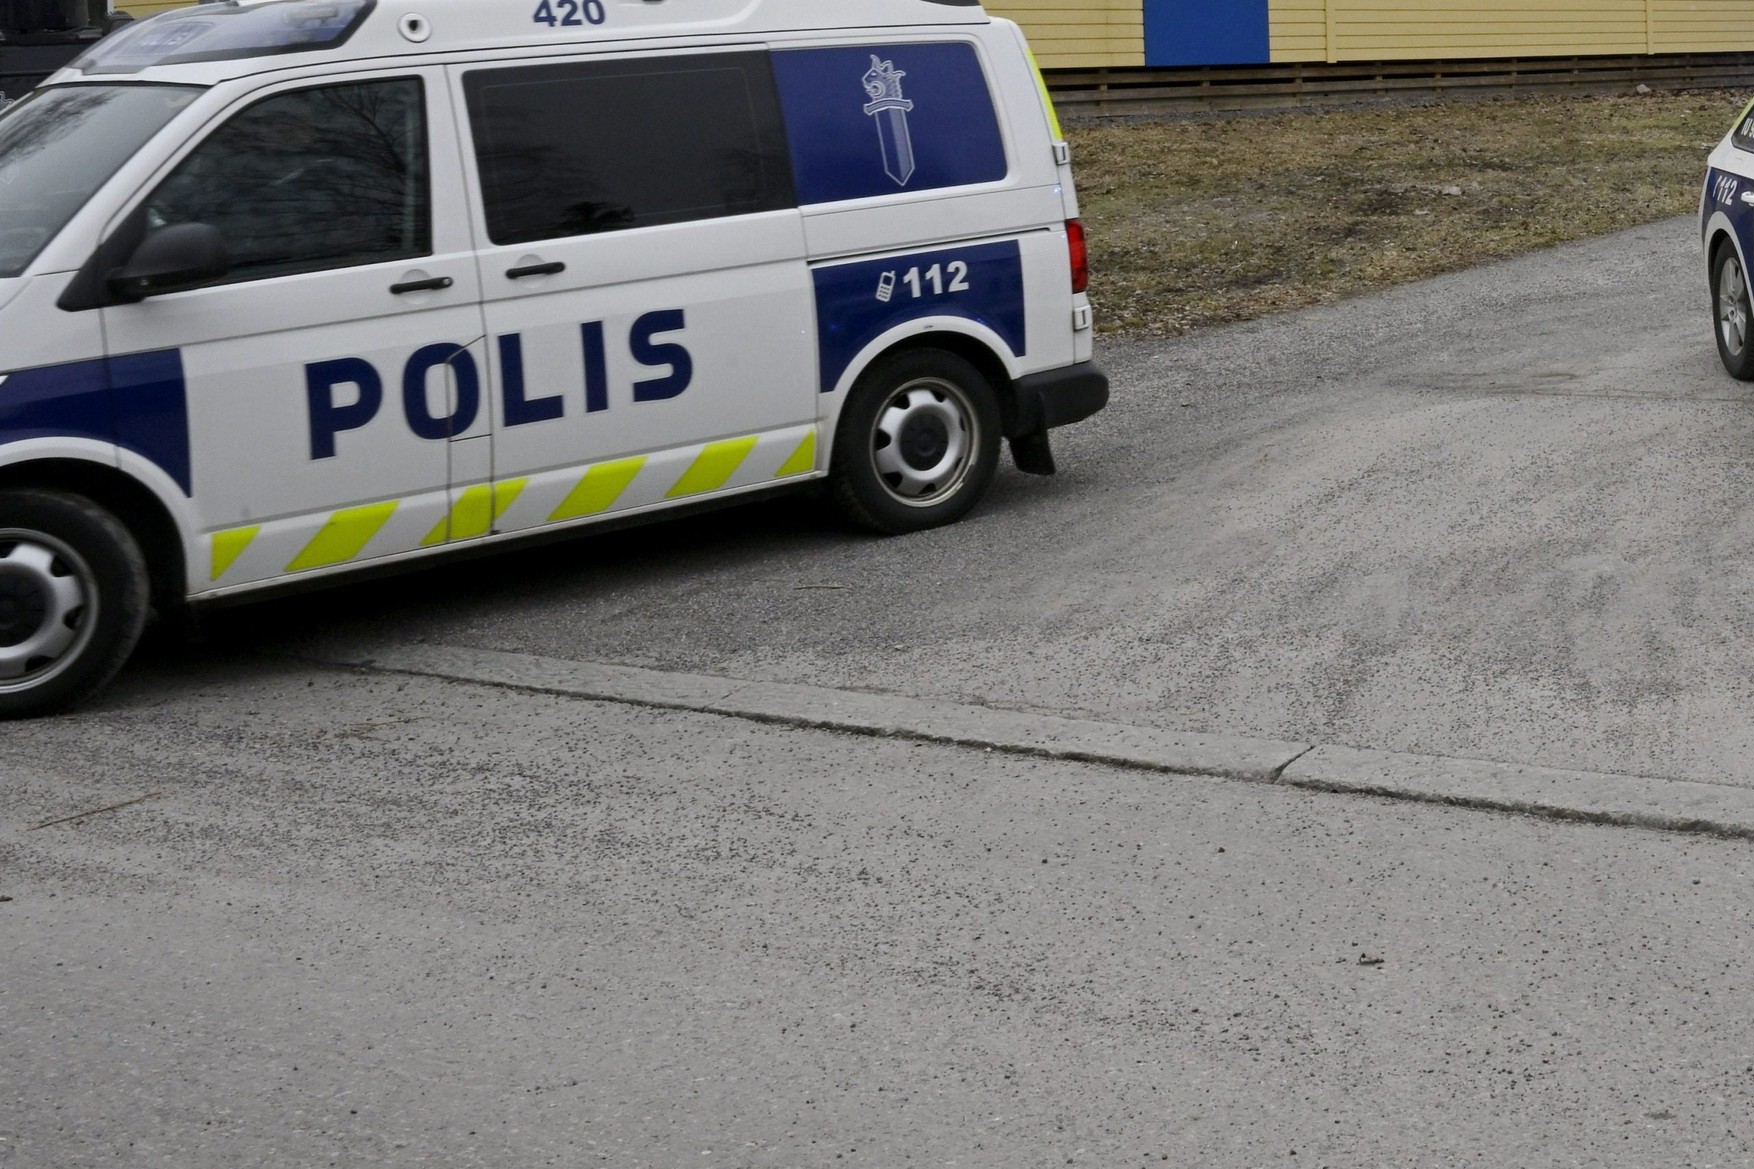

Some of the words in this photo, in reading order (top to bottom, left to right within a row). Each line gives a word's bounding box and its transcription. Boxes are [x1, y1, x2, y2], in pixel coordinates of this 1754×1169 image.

[1717, 178, 1737, 206] 112
[903, 260, 970, 298] 112
[305, 308, 693, 460] POLIS
